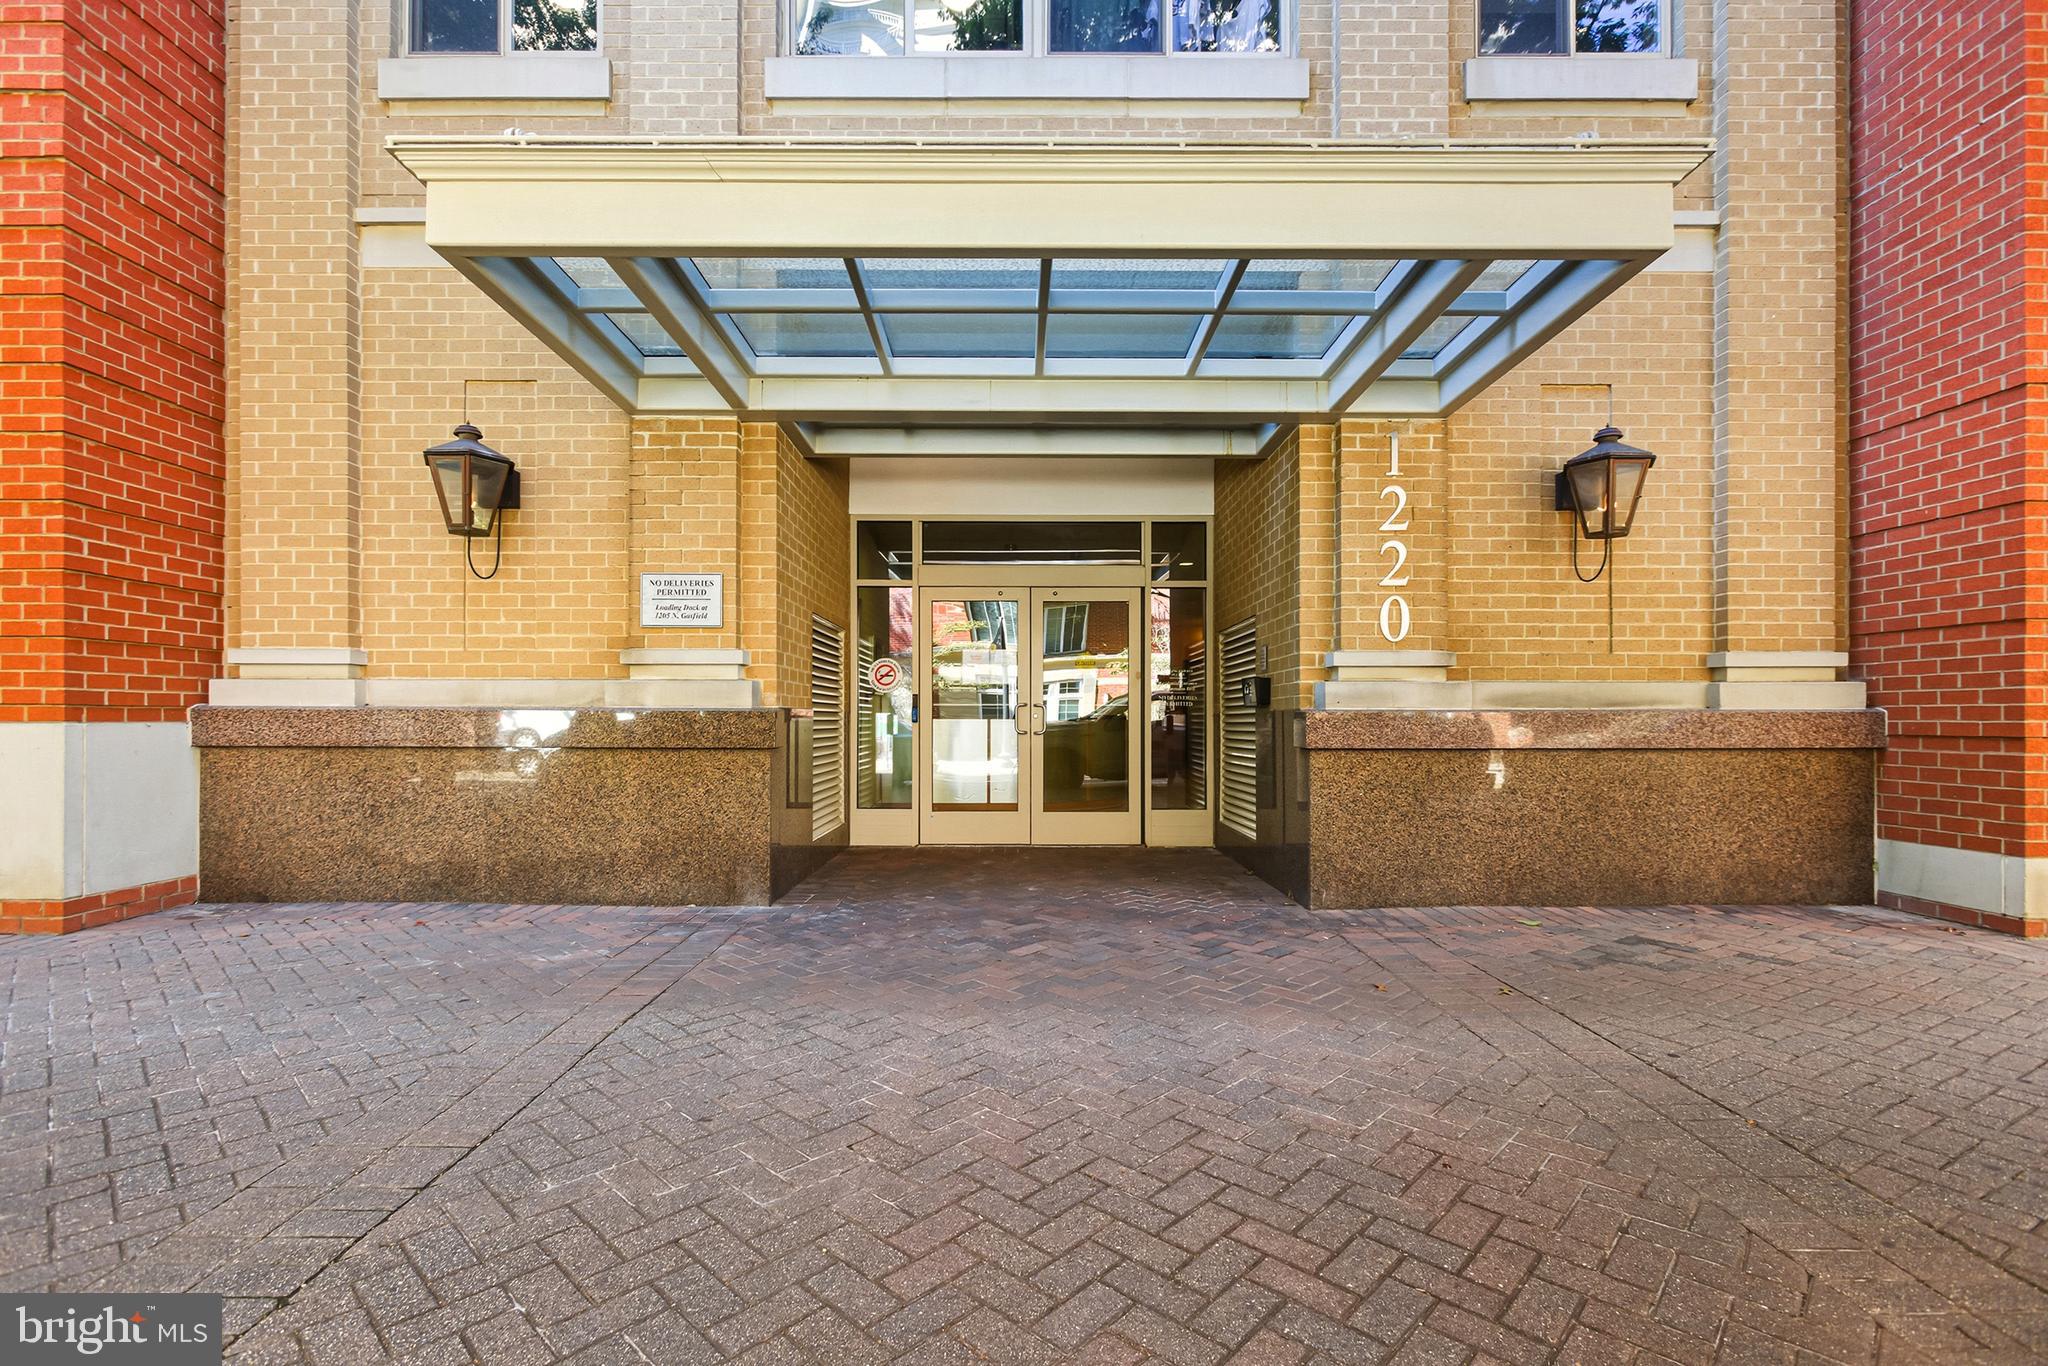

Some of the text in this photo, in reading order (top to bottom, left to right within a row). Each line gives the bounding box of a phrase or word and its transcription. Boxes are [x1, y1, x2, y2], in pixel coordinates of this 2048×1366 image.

[1377, 430, 1410, 643] 1220
[650, 579, 714, 587] NO DELIVERIES
[656, 588, 707, 596] PERMITTED
